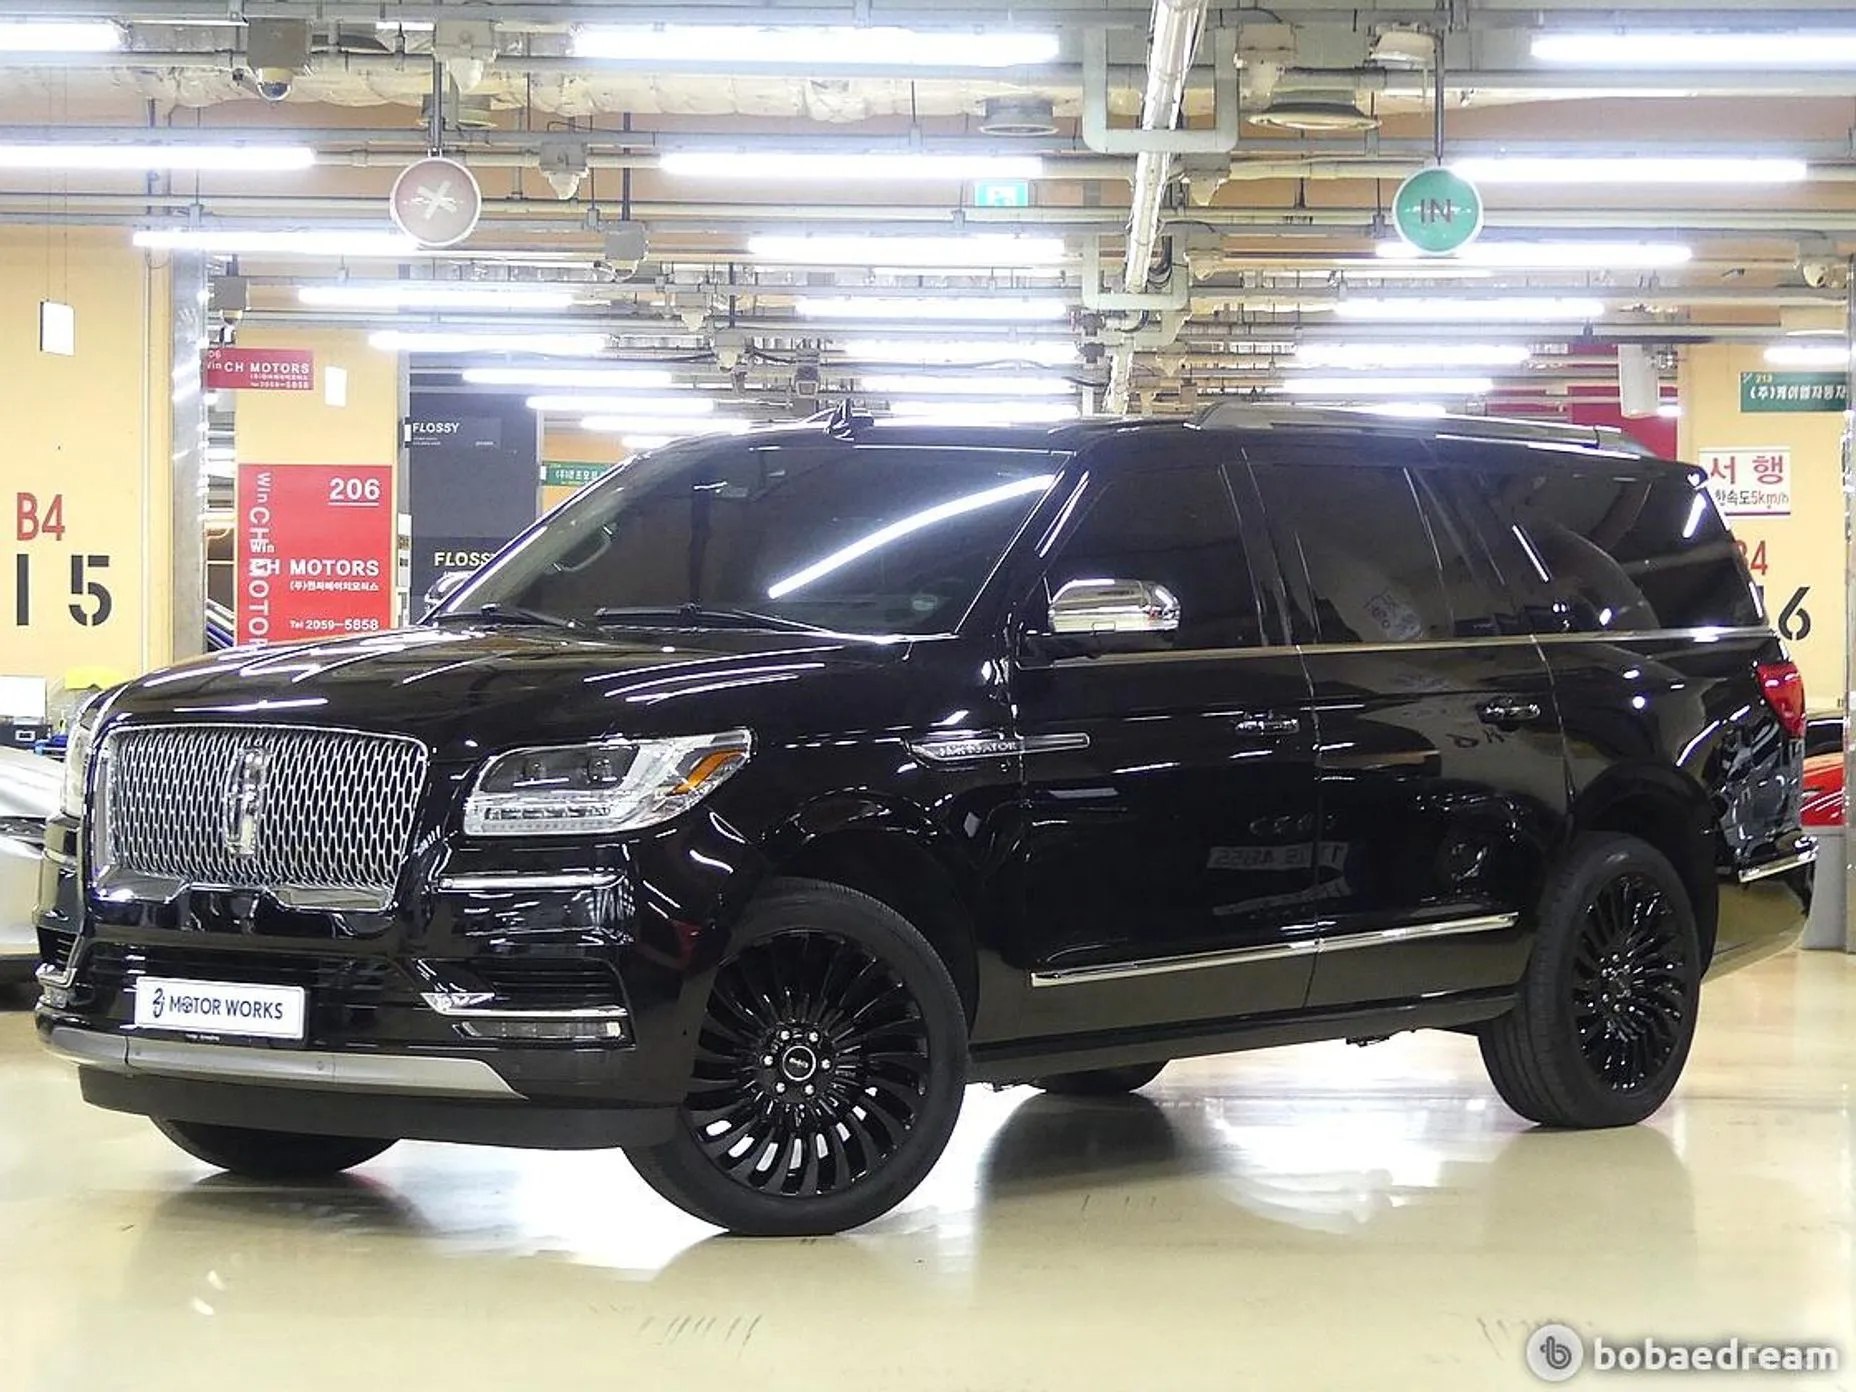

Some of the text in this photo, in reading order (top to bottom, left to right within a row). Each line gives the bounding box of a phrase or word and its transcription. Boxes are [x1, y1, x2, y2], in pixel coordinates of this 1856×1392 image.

[1421, 199, 1451, 222] IN
[250, 362, 310, 374] MOTORS
[412, 422, 460, 434] FLOSSY
[329, 478, 380, 501] 206
[17, 492, 65, 541] B4
[290, 559, 379, 576] MOTORS
[305, 619, 379, 631] 2059-5858
[169, 996, 221, 1016] MOTOR
[226, 1000, 283, 1020] WORKS
